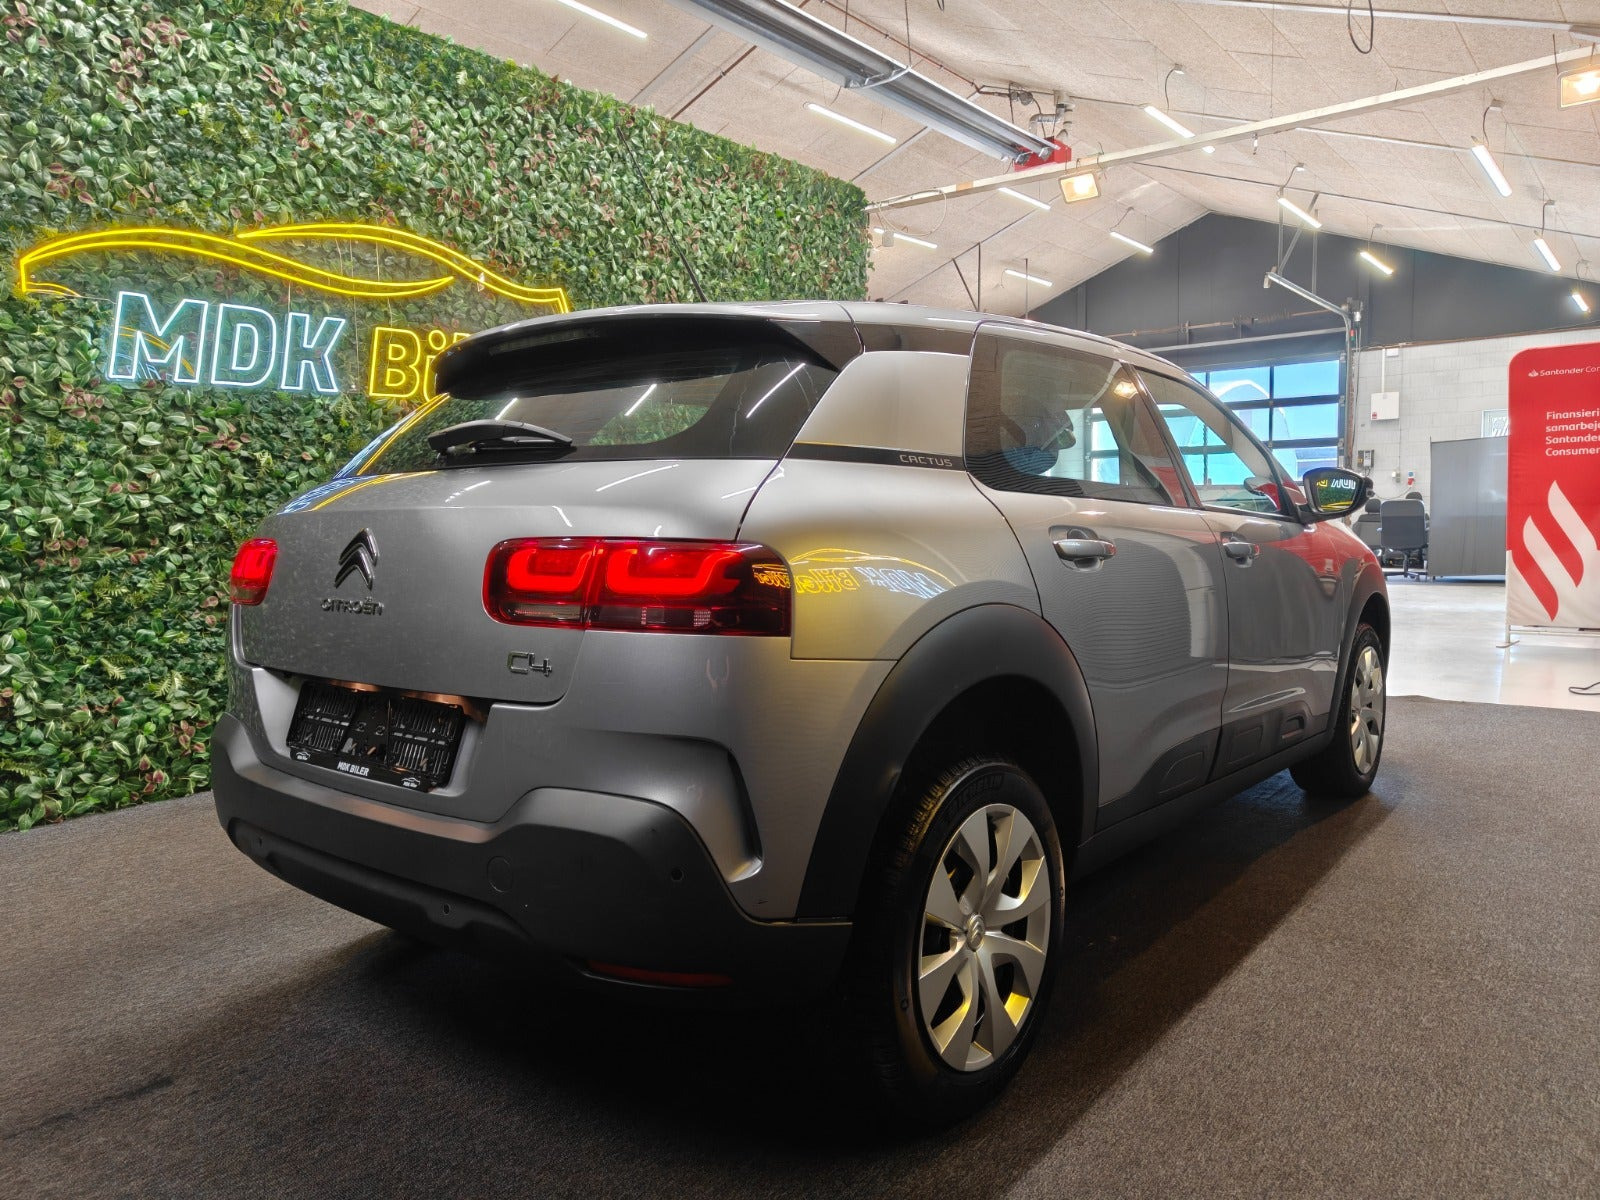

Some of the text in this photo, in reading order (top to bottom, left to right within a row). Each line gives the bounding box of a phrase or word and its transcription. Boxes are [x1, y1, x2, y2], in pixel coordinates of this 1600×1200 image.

[108, 290, 472, 403] MDK Bi
[1539, 367, 1585, 377] Santander
[1546, 407, 1600, 420] Finansieri
[1545, 447, 1600, 457] Consumer
[899, 454, 953, 467] CACTUS
[507, 650, 552, 677] C4
[350, 764, 370, 777] BILER
